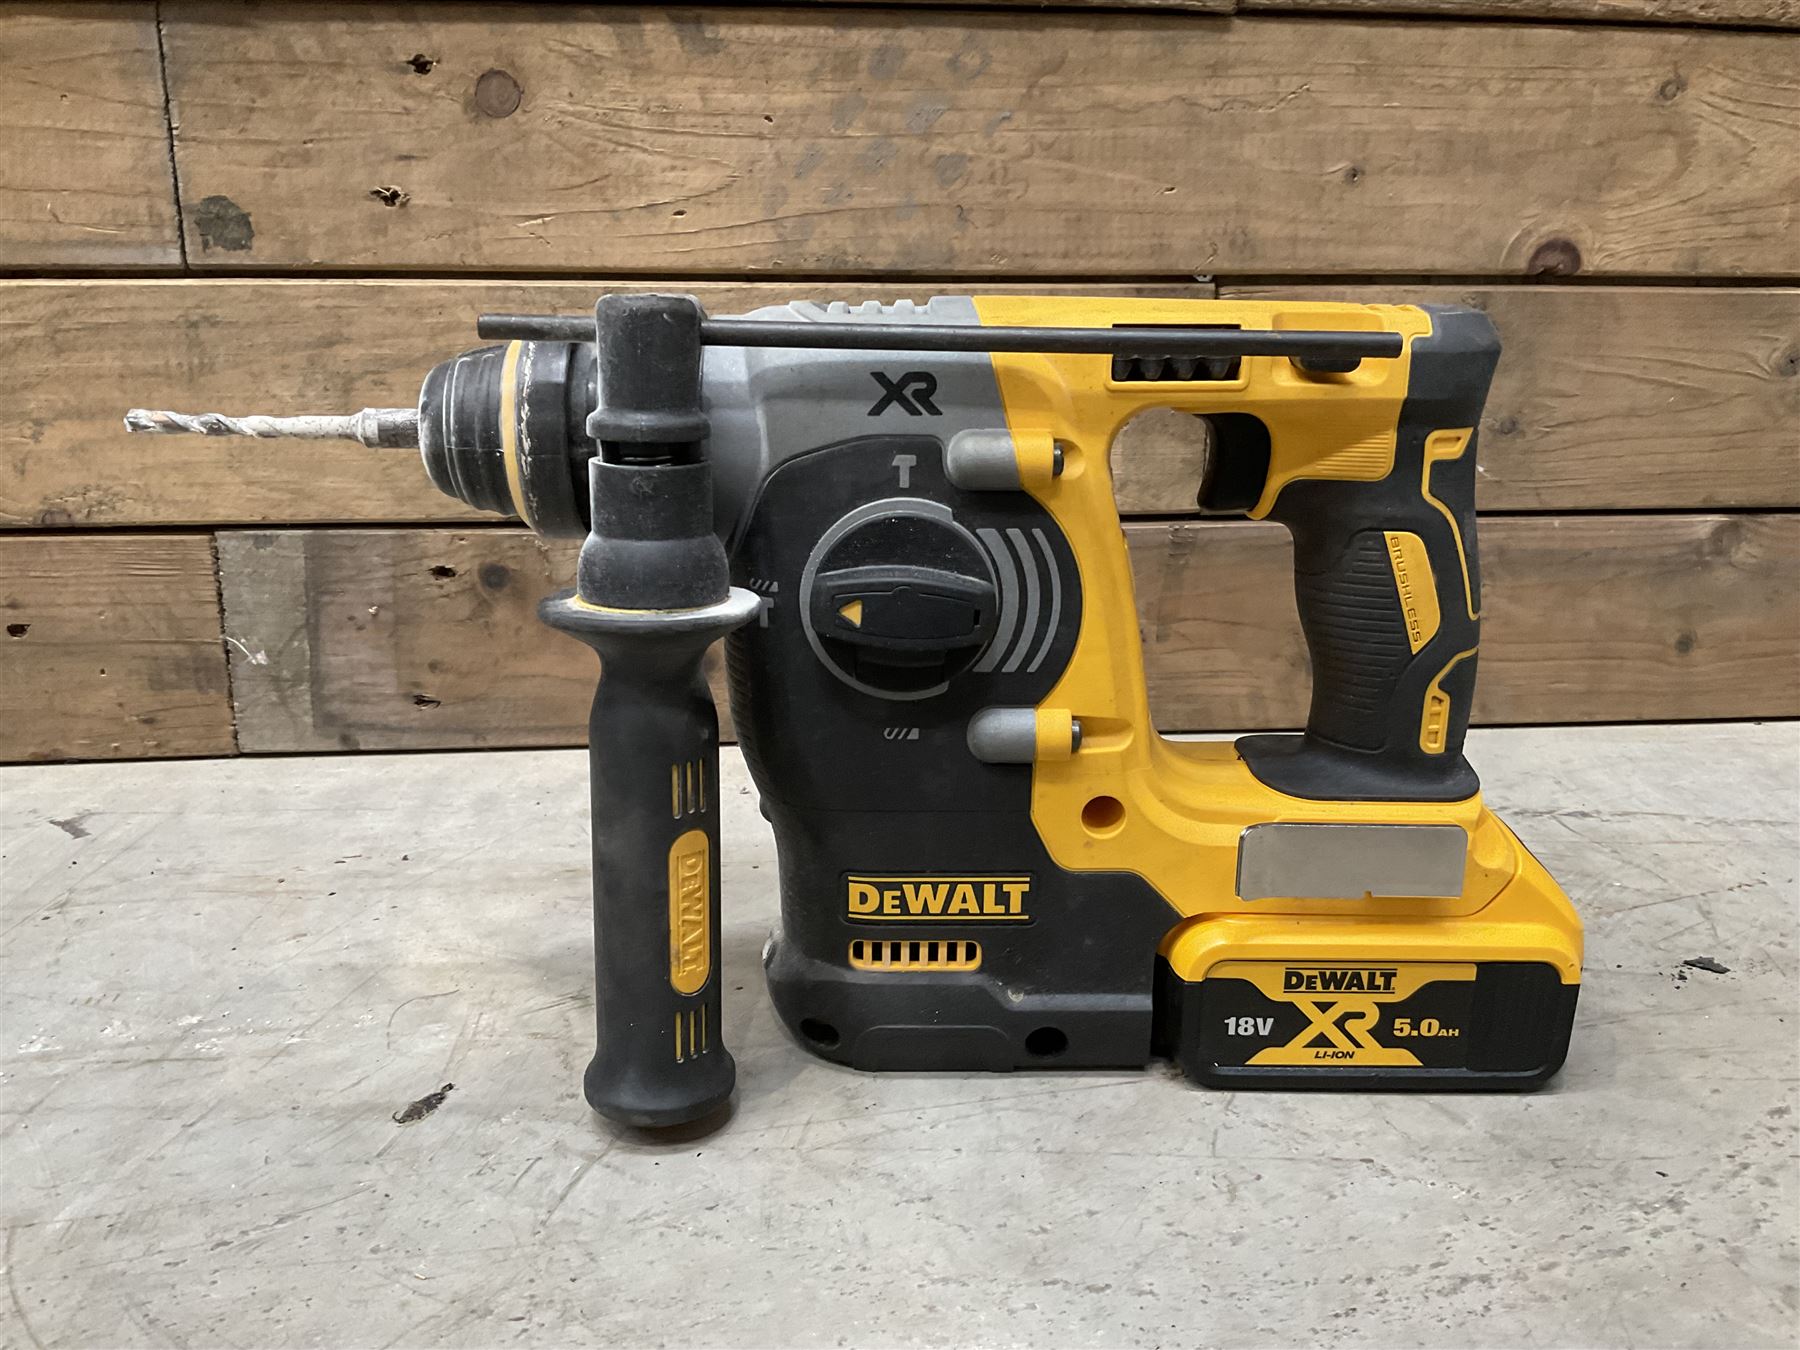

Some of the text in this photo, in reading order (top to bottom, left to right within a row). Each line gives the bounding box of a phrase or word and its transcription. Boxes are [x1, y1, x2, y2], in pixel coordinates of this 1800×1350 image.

[867, 371, 943, 416] XR
[1390, 536, 1422, 643] BRUSHLESS
[1224, 1017, 1274, 1036] 18V
[1283, 1001, 1383, 1048] XR
[1314, 1050, 1355, 1060] LI-ION
